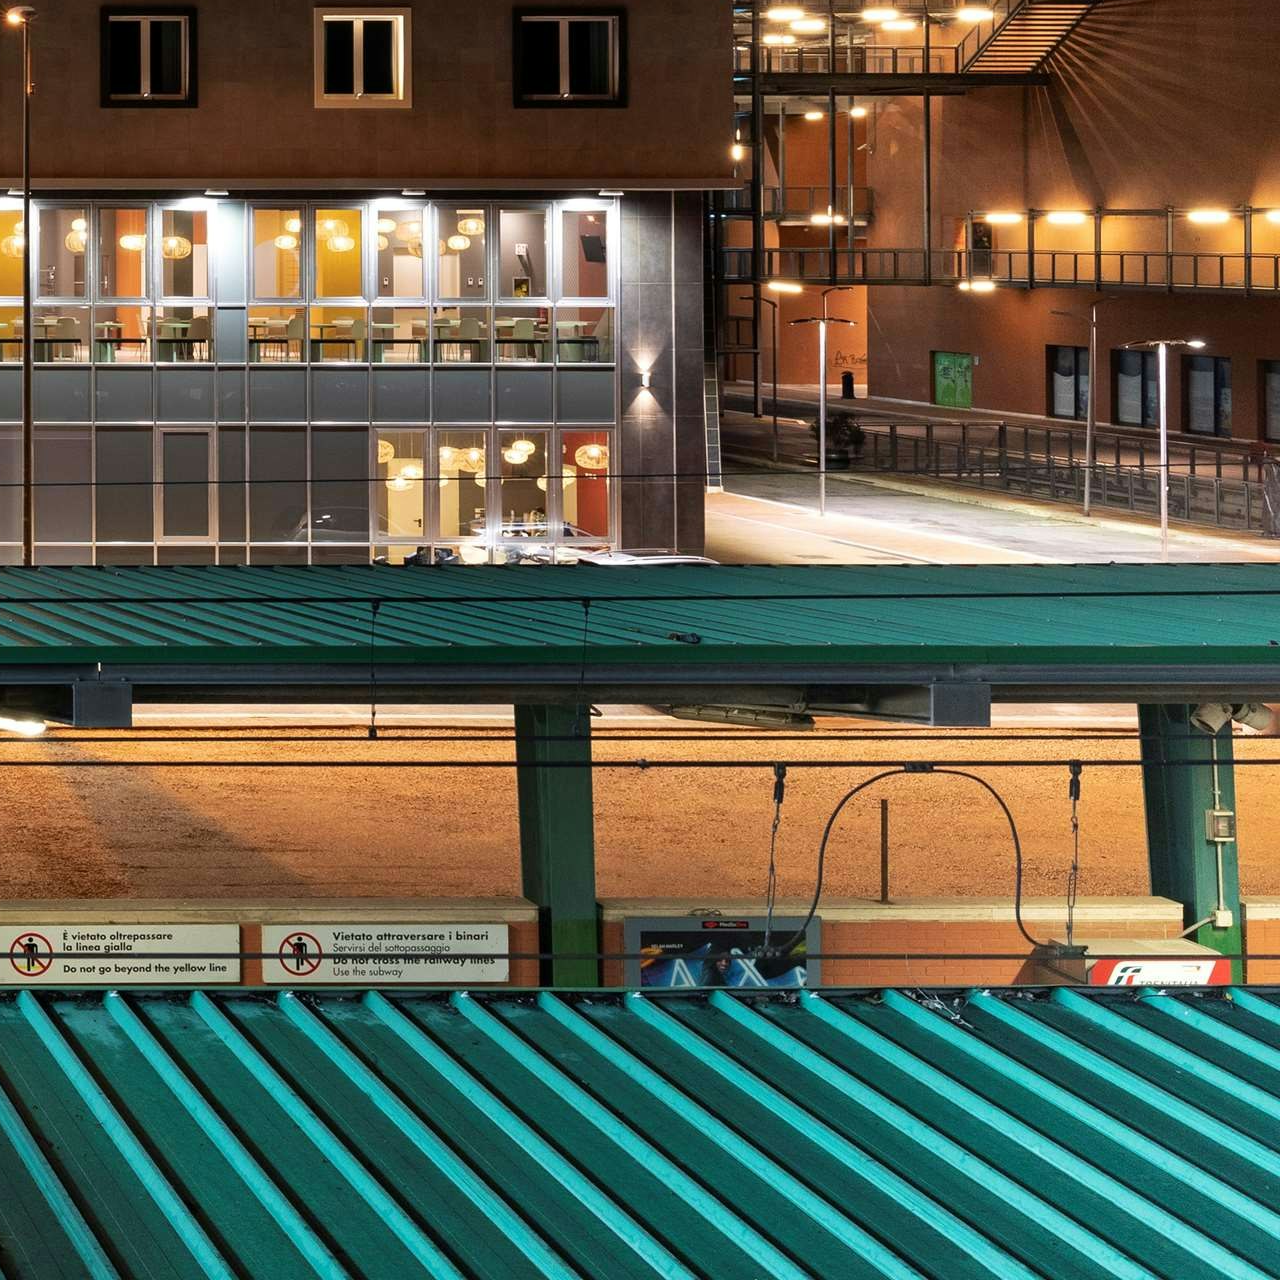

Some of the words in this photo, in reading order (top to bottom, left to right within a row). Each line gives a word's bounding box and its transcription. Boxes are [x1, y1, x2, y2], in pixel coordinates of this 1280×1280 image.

[62, 930, 68, 941] È
[71, 932, 107, 941] vietato
[109, 932, 173, 943] oltrepassare
[332, 932, 373, 941] Vietato
[376, 932, 445, 941] attraversare
[455, 931, 489, 941] binari
[63, 942, 73, 952] la
[76, 942, 101, 952] linea
[103, 942, 133, 954] gialla
[333, 943, 366, 953] Servirsi
[368, 943, 382, 953] del
[384, 944, 451, 955] sottopassaggio
[333, 955, 350, 965] Do
[351, 955, 370, 965] not
[372, 956, 400, 965] cross
[63, 965, 77, 973] Do
[79, 965, 96, 973] not
[99, 966, 112, 975] go
[114, 964, 152, 975] beyond
[154, 964, 170, 973] the
[173, 963, 207, 974] yellow
[209, 963, 227, 972] line
[333, 968, 350, 977] Use
[352, 967, 366, 977] the
[369, 967, 403, 978] subway
